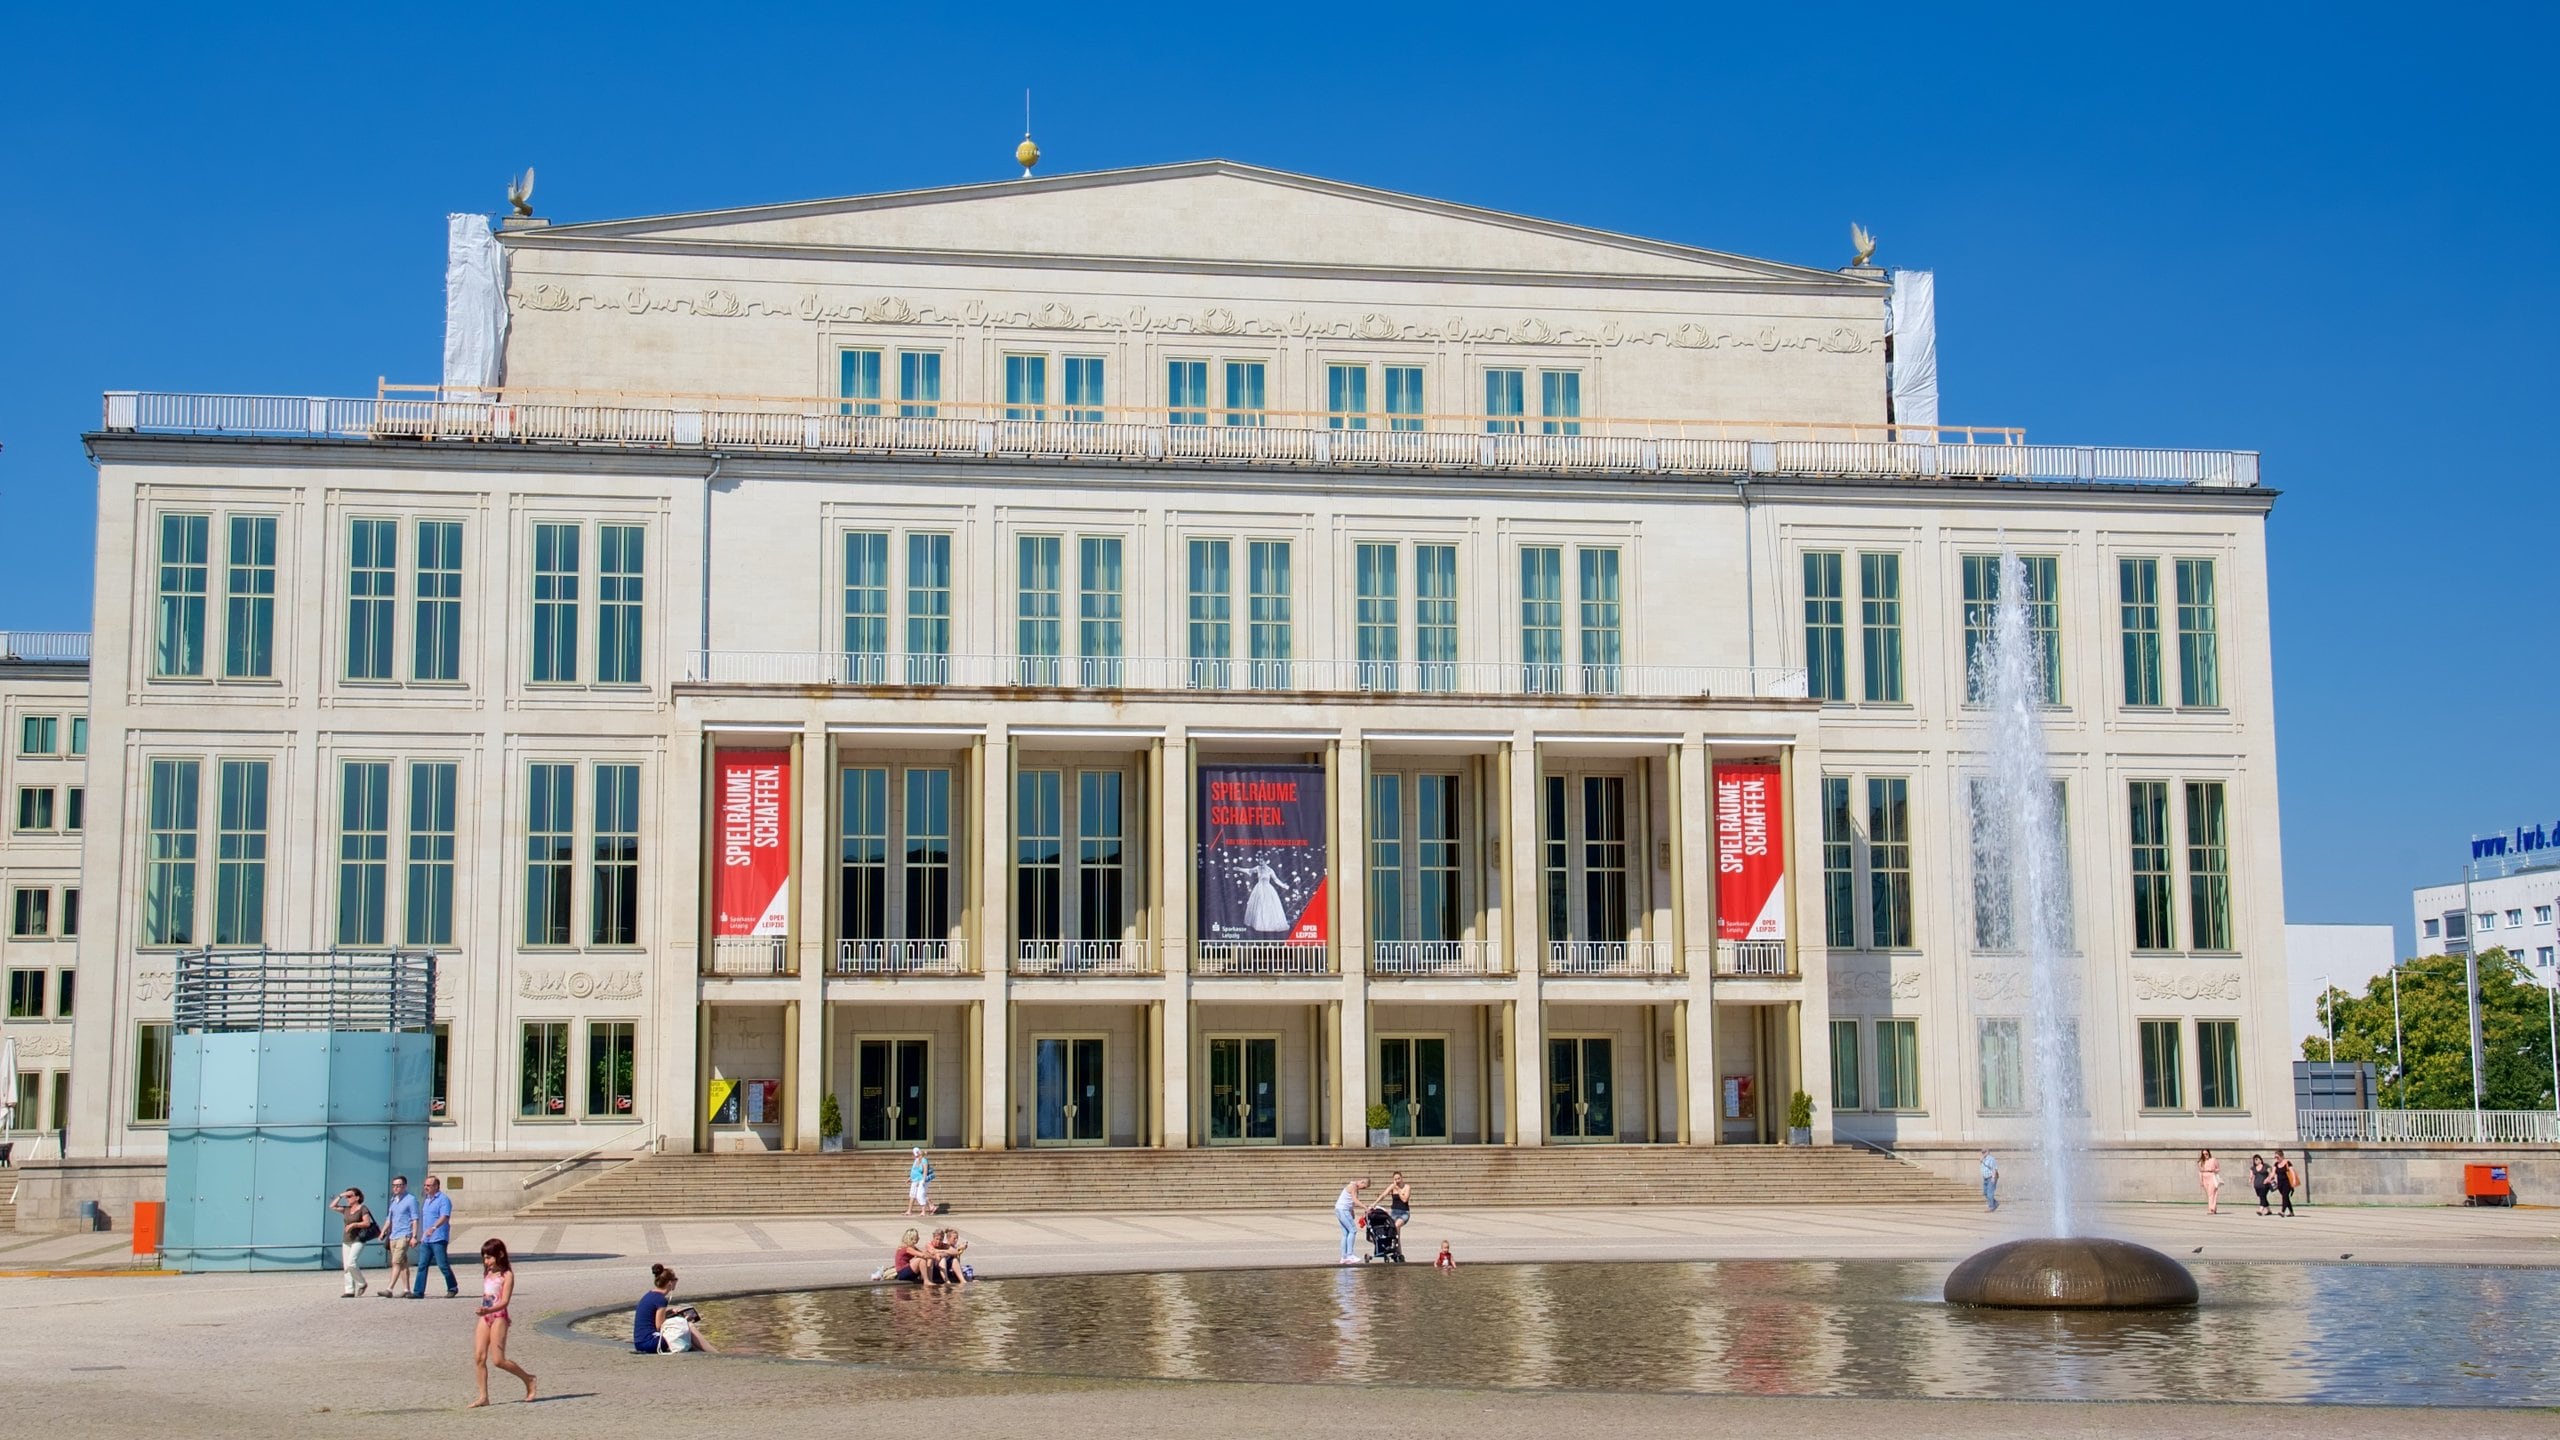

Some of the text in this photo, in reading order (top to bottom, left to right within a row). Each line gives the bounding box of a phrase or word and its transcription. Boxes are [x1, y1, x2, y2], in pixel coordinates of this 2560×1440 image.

[723, 769, 752, 867] SPIELRÄUME
[753, 765, 780, 849] SCHAFFEN.
[1211, 779, 1297, 802] SPIELRÄUME
[1211, 805, 1285, 827] SCHAFFEN.
[1716, 780, 1744, 874] SPIELRÄUME
[1743, 776, 1768, 856] SCHAFFEN.
[1221, 932, 1241, 940] Leipzig
